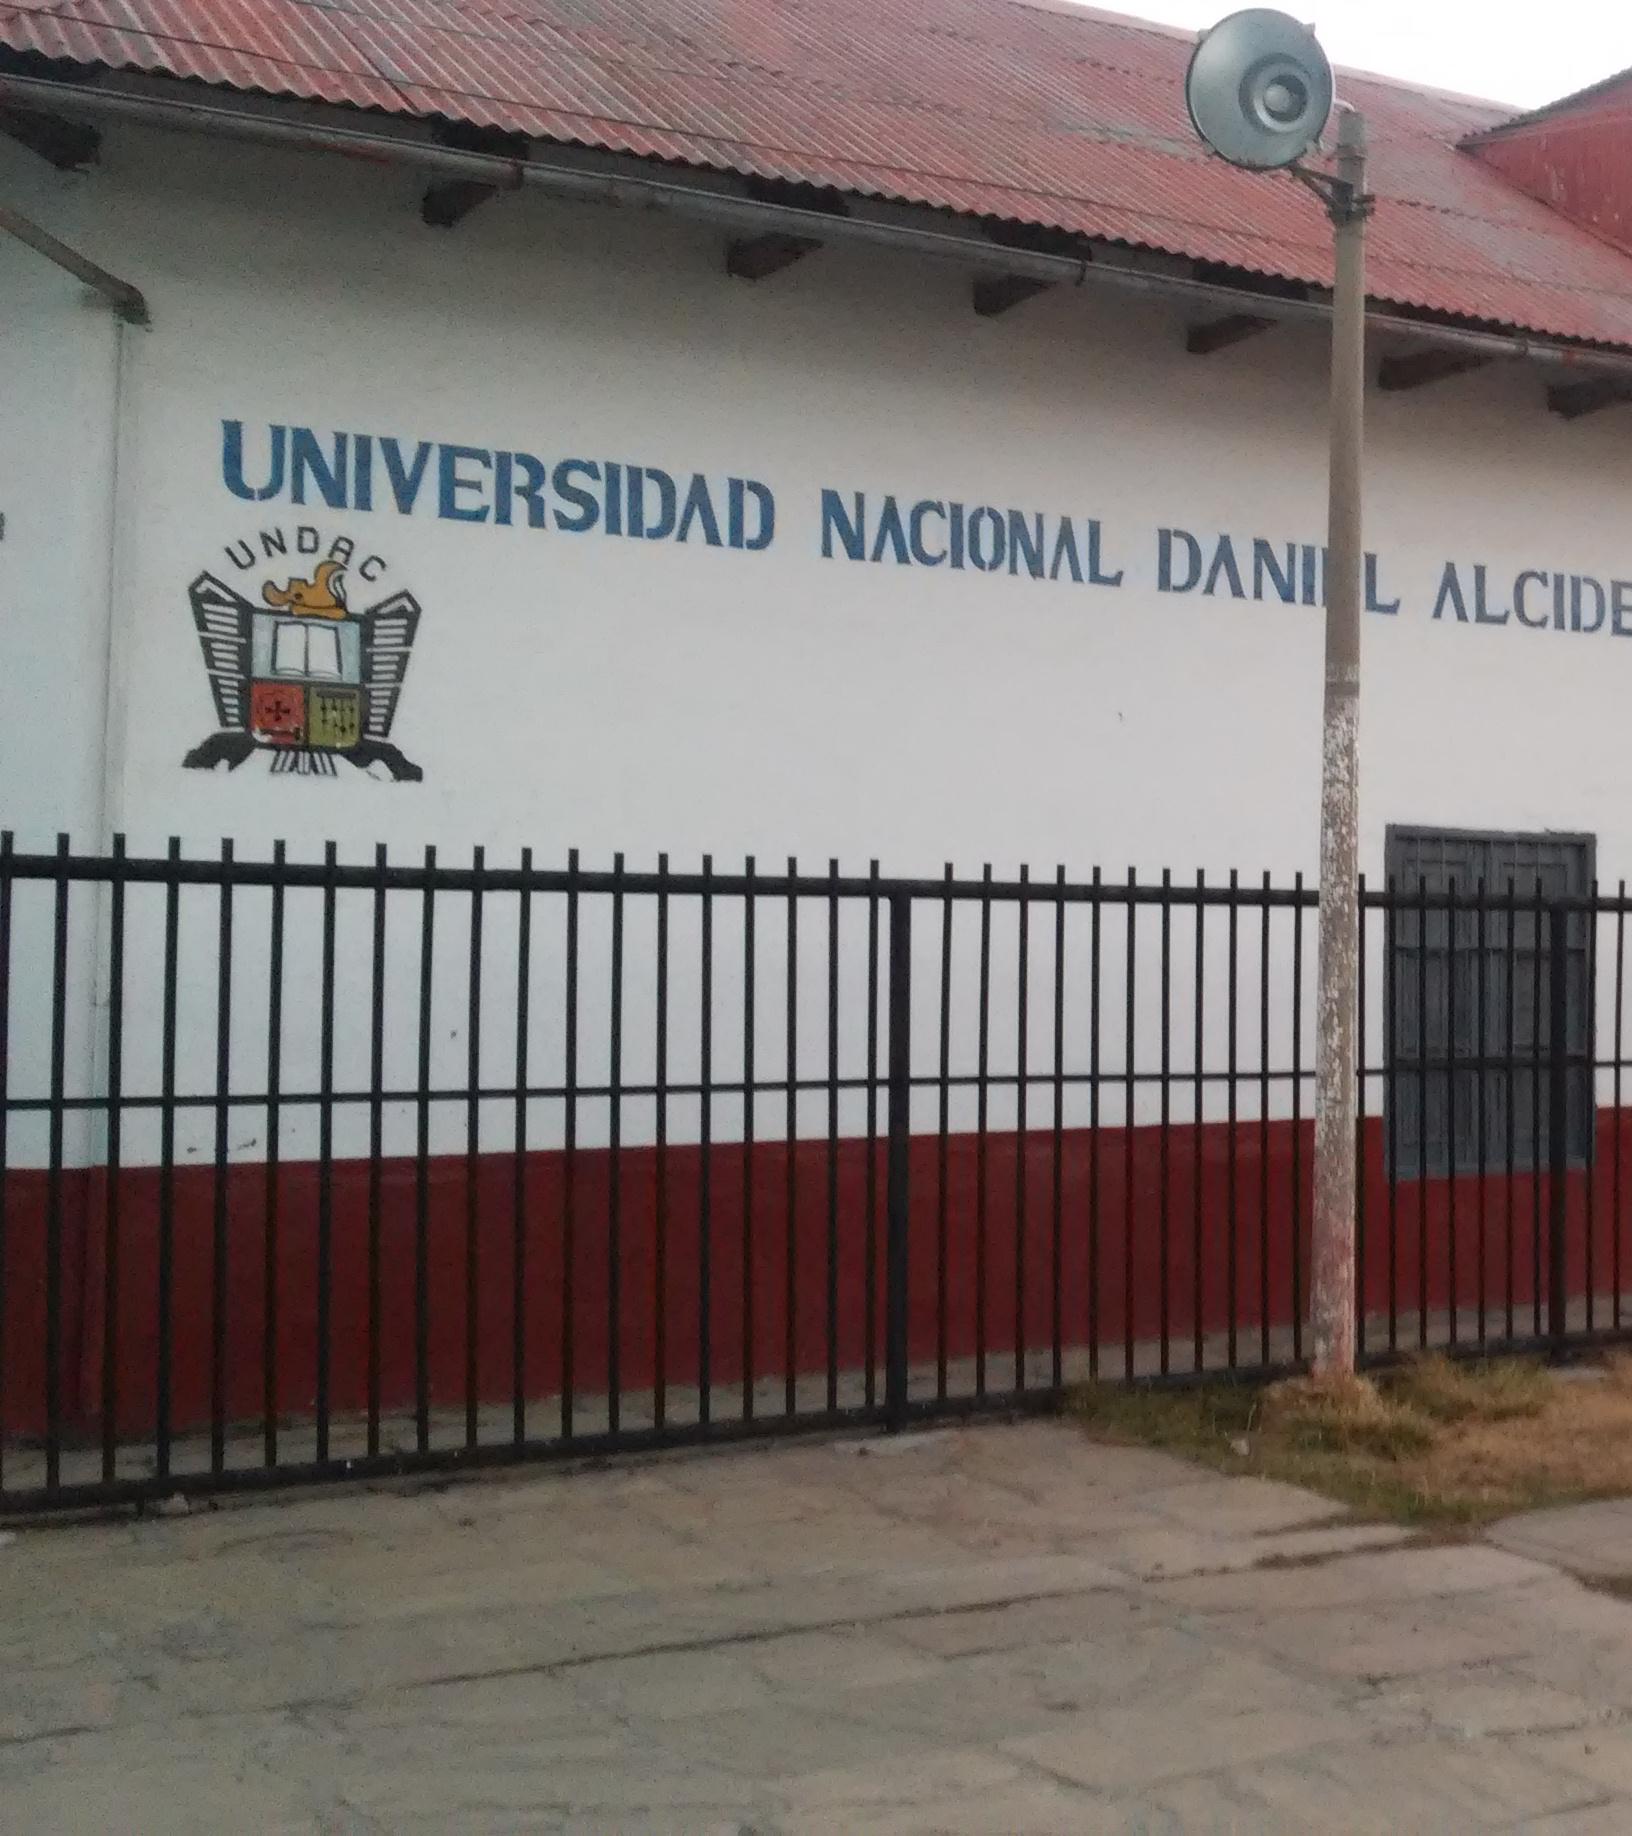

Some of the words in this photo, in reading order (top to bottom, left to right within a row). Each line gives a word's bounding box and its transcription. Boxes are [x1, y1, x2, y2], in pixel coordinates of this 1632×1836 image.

[219, 418, 777, 552] UNIVERSIDAD
[818, 487, 1123, 588] NACIONAL
[1156, 527, 1400, 615] DANIL
[224, 525, 388, 583] UNDAC
